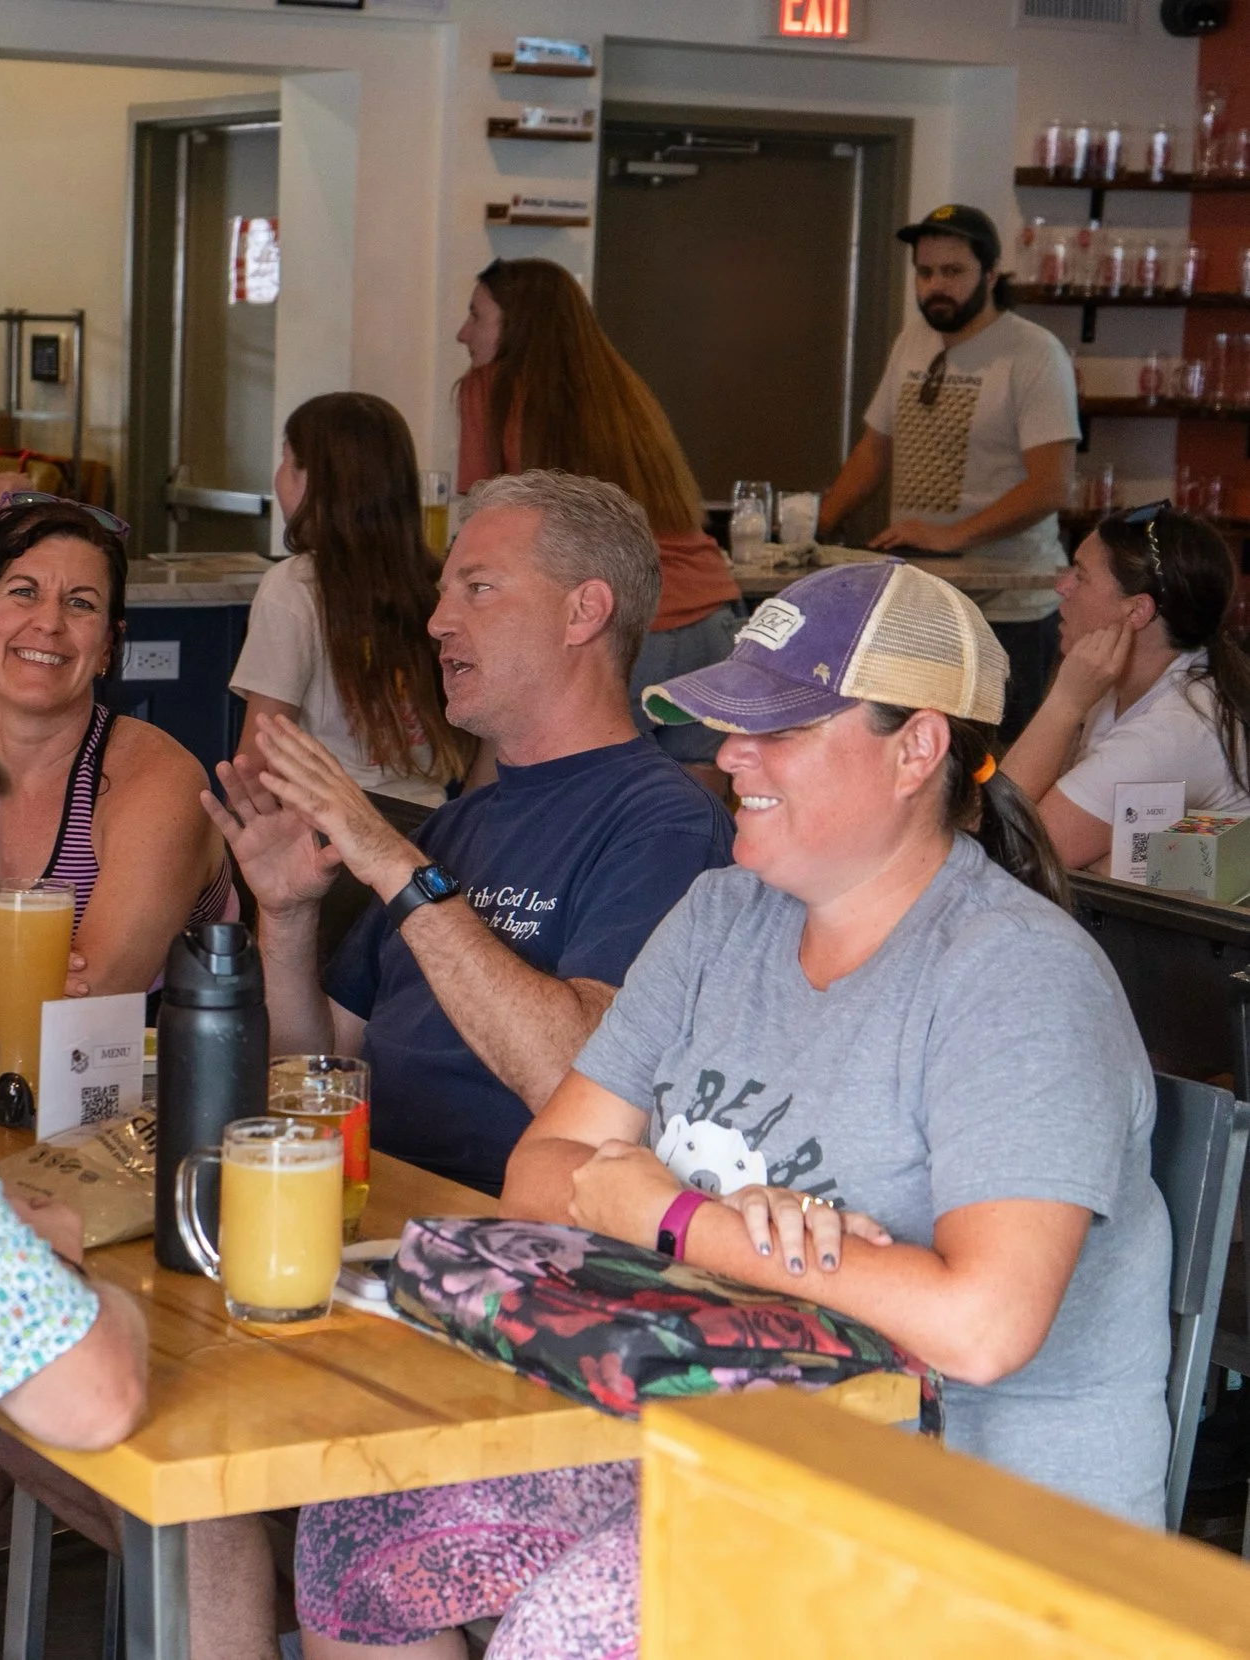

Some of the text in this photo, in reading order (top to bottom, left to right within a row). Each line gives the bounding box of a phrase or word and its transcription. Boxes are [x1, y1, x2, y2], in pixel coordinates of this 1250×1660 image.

[497, 886, 529, 907] God
[502, 910, 541, 940] happy.
[100, 1046, 132, 1060] MENU
